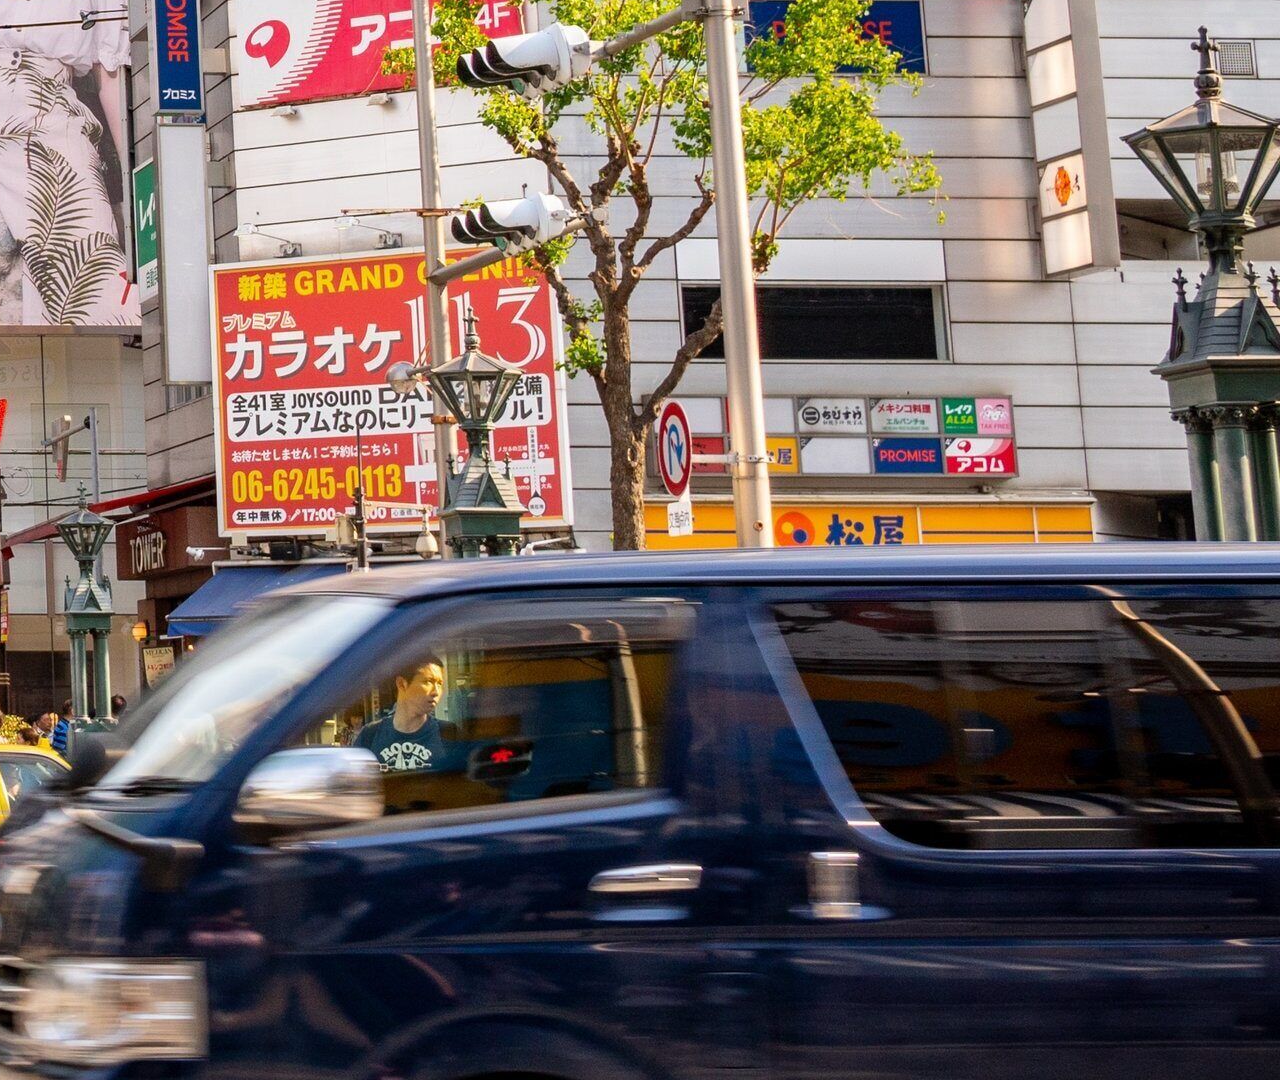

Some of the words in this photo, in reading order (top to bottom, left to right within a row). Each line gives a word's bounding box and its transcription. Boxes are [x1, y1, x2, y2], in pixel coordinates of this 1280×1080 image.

[473, 0, 511, 30] 4F
[162, 88, 197, 100] プロミス
[237, 272, 288, 302] 新築
[294, 262, 405, 297] GRAND
[222, 310, 297, 333] プレミアム
[224, 322, 402, 381] カラオケ
[232, 392, 287, 414] 全41室
[291, 389, 372, 410] JOYSOUND
[877, 403, 932, 415] メキシコ料理
[945, 404, 972, 415] レイク
[946, 415, 974, 424] ALSA
[879, 449, 936, 463] PROMISE
[956, 457, 1005, 473] アコム
[232, 463, 402, 504] 06-6245-0113
[236, 509, 284, 523] 年中無休
[824, 513, 904, 546] 松屋
[129, 531, 167, 575] TOWER
[380, 741, 432, 762] ROOTS
